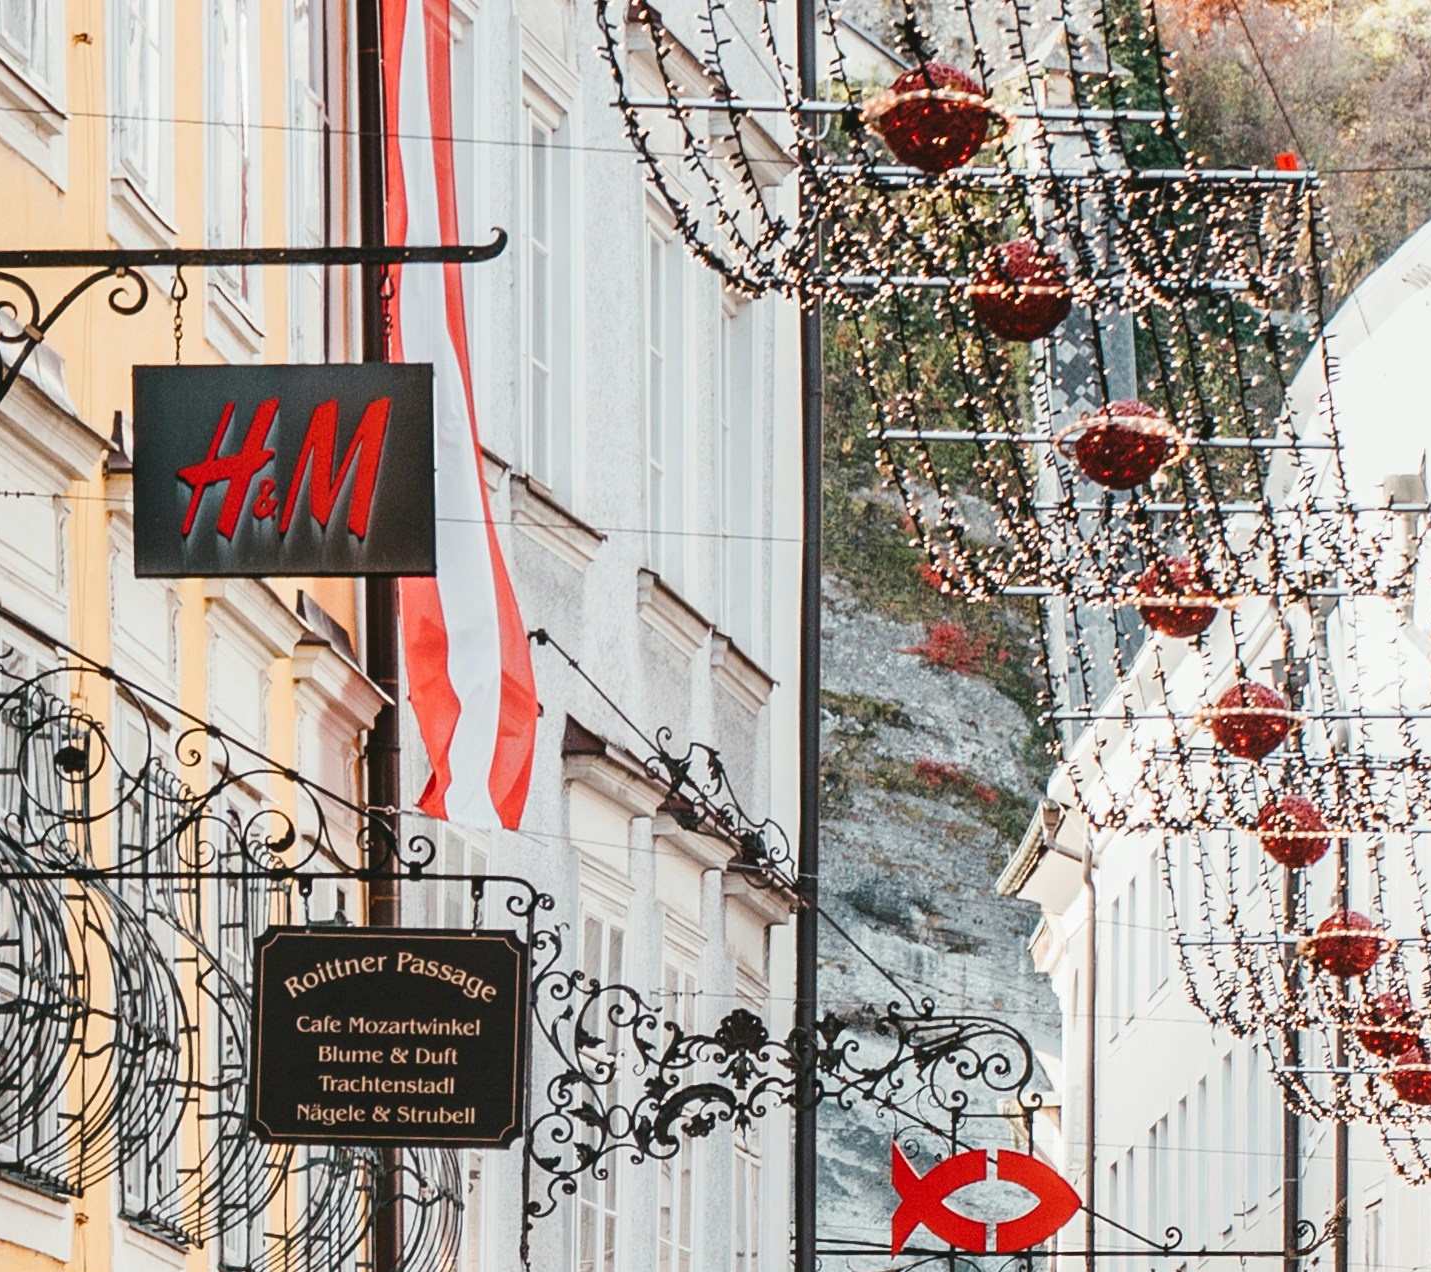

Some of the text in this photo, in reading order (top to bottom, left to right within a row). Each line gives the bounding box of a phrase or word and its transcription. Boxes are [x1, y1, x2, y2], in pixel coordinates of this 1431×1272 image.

[175, 397, 392, 541] H&M
[284, 952, 498, 1003] Roittner Passage
[296, 1015, 482, 1036] Cafe Mozartwinkel
[318, 1046, 458, 1065] Blume & Duft
[319, 1075, 455, 1095] Trachtenstadl
[297, 1104, 476, 1126] Nägele & Strubell
